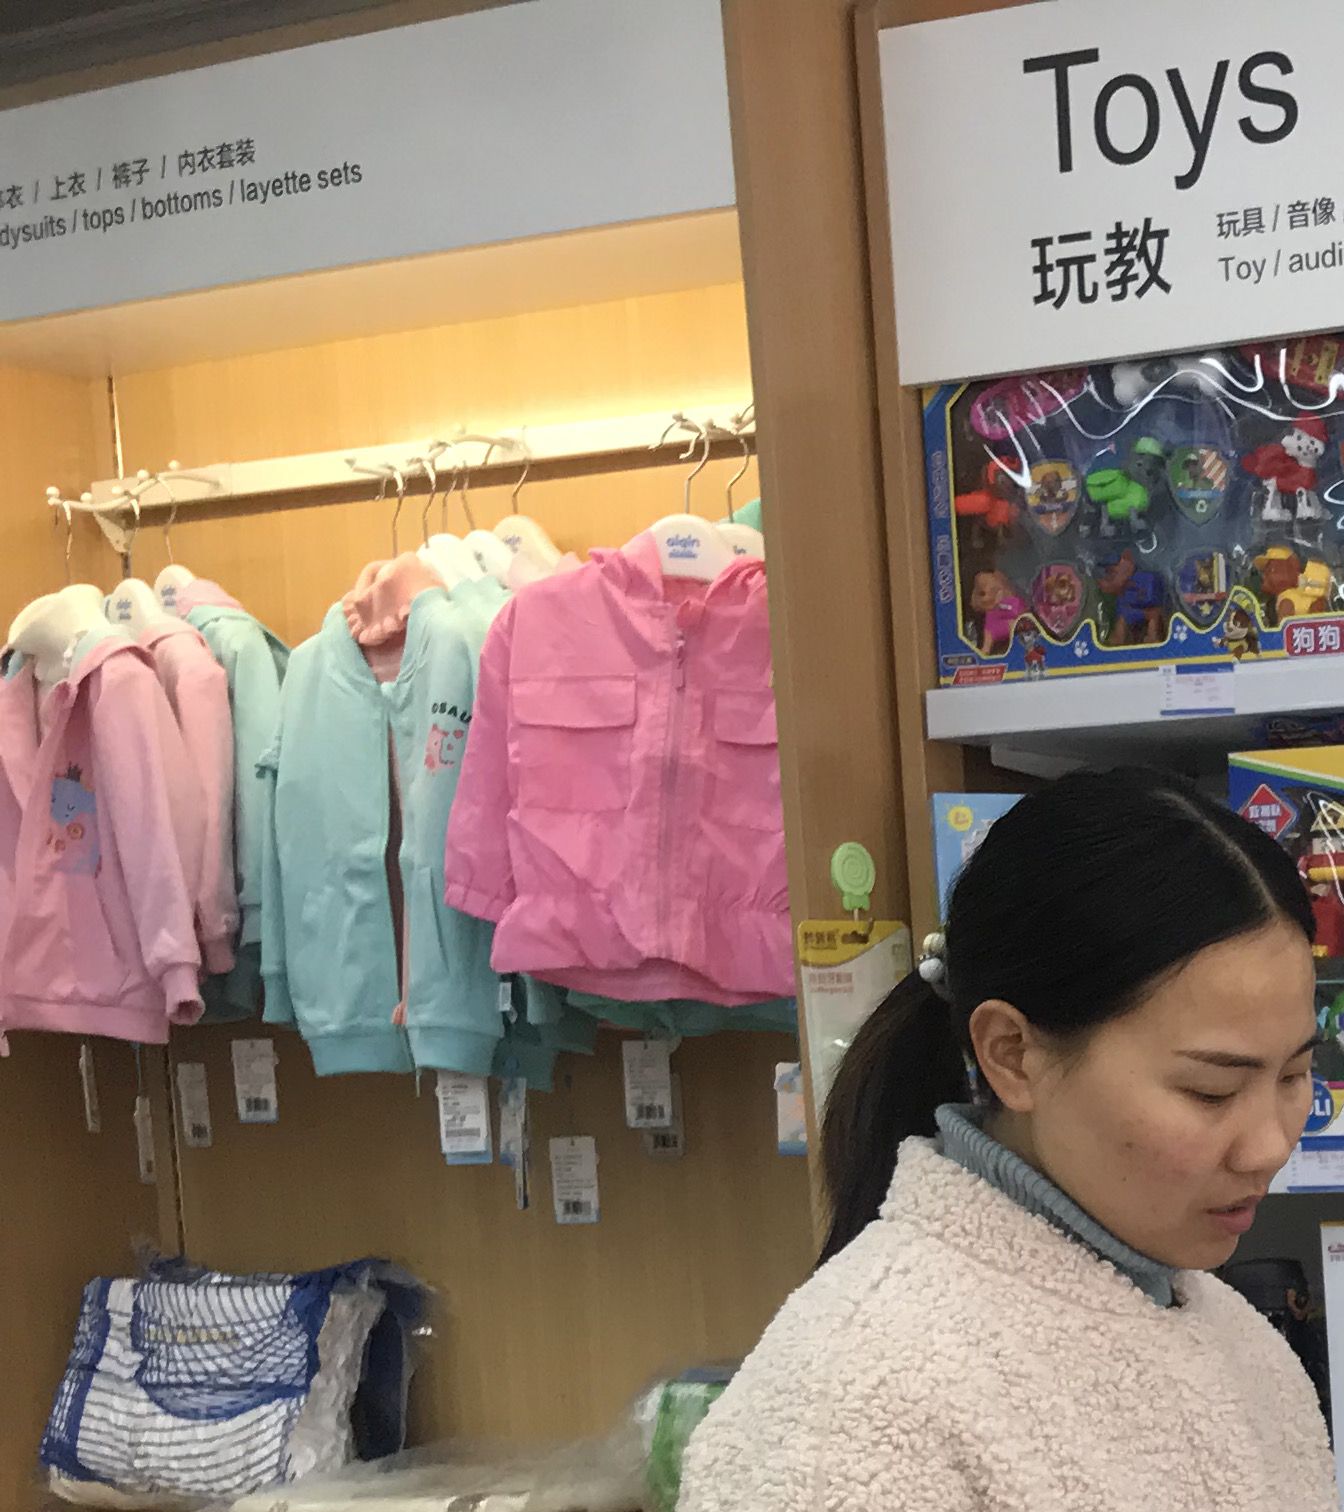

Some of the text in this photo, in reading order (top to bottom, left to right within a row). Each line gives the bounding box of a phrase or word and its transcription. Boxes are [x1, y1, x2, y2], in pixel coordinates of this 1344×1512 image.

[1022, 47, 1299, 190] Toys
[0, 138, 256, 210] 衣 上衣 裤子 内衣套装
[82, 203, 125, 233] tops
[141, 187, 224, 221] bottoms
[240, 173, 311, 206] layette
[317, 160, 363, 190] sets
[1216, 207, 1266, 241] 玩具
[1287, 197, 1336, 231] 音像
[1030, 216, 1172, 311] 玩教
[1218, 255, 1266, 284] Toy
